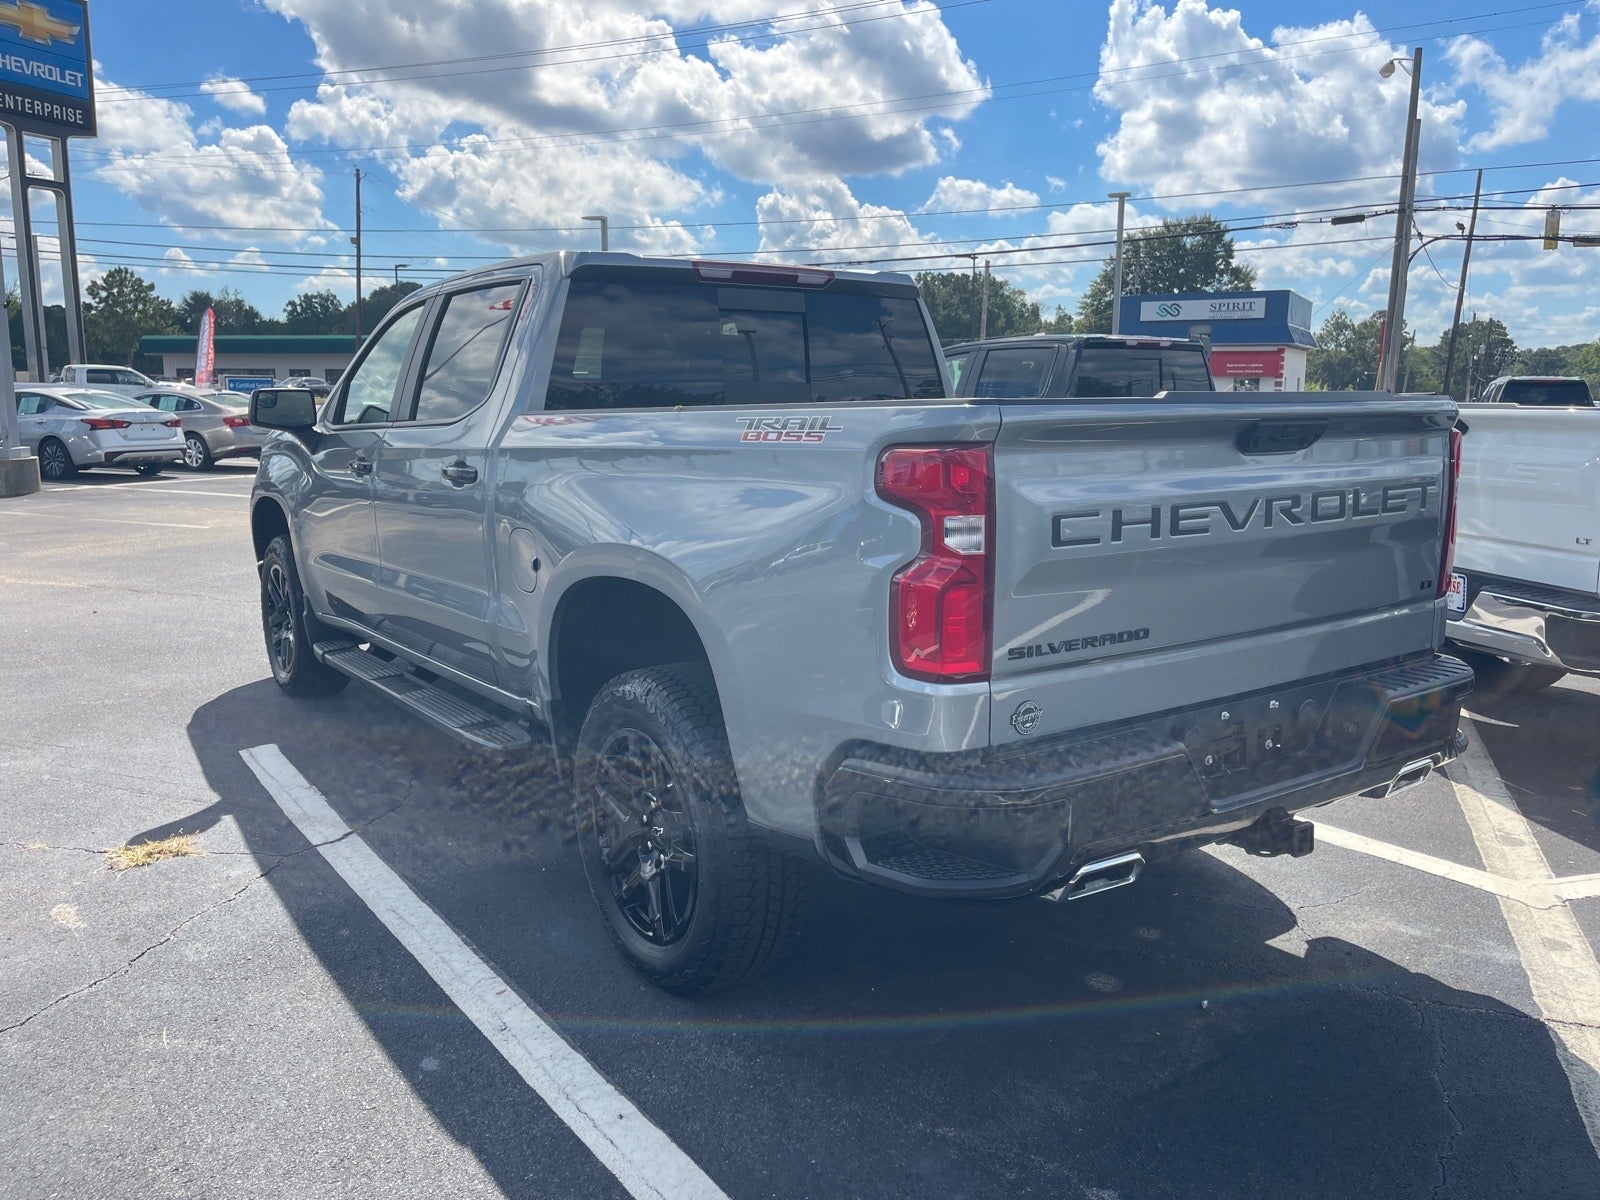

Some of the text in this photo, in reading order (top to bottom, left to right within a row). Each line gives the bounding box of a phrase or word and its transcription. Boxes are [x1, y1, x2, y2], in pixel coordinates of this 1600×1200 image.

[0, 53, 84, 88] HEVROLET
[1209, 301, 1256, 311] SPIRIT
[736, 416, 843, 432] TRAIL
[740, 430, 826, 443] BOSS
[1051, 480, 1438, 548] CHEVROLET
[1575, 537, 1592, 545] LT
[1420, 580, 1432, 590] LT
[1007, 627, 1150, 660] SILVERADO
